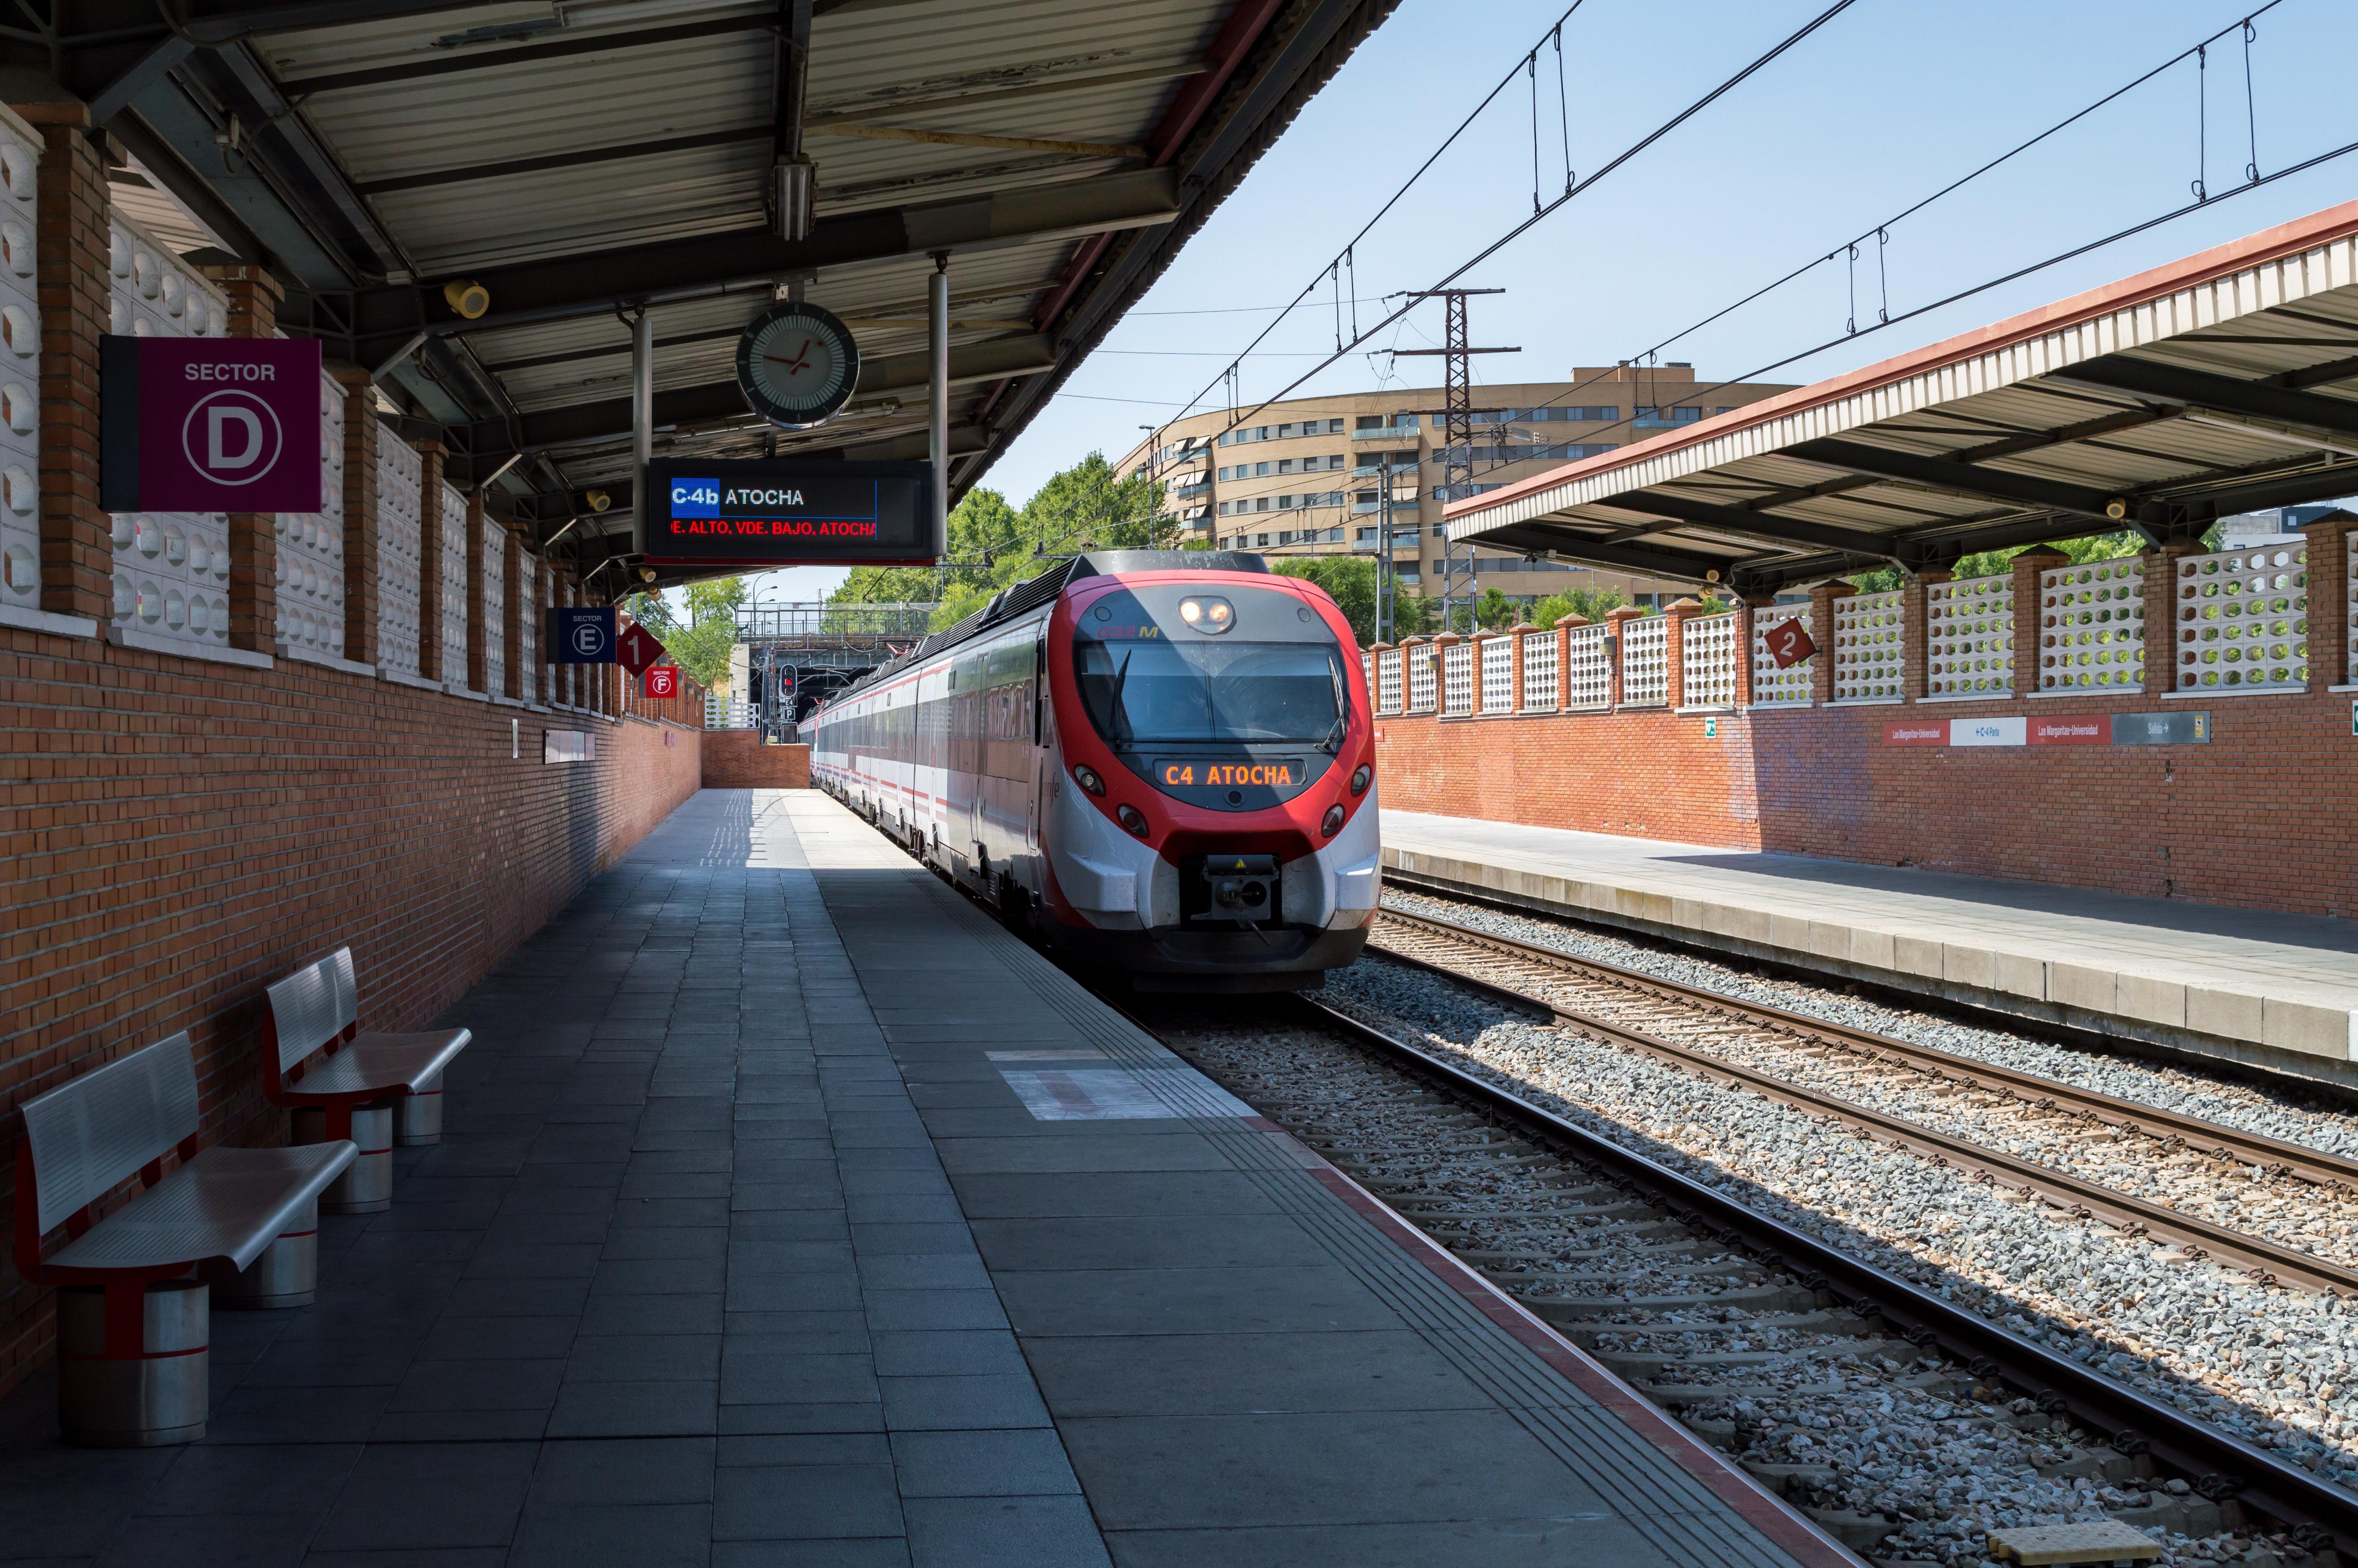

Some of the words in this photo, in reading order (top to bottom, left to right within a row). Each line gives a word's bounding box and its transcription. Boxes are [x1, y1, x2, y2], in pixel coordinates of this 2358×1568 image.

[185, 363, 275, 381] SECTOR
[208, 406, 263, 468] D
[725, 489, 804, 505] ATOCHA
[671, 521, 685, 533] E.
[689, 521, 732, 535] ALTO,
[736, 522, 768, 534] VDE.
[772, 522, 816, 535] BAJO,
[580, 630, 596, 650] E
[1780, 631, 1796, 657] 2
[628, 635, 639, 665] 1
[657, 679, 666, 690] F
[787, 710, 792, 719] P
[1899, 728, 1940, 740] Margaritas-Universidad
[1990, 727, 2000, 736] Parla
[2038, 725, 2046, 736] Las
[2047, 724, 2098, 738] Margaritas-Universidad
[2148, 723, 2163, 734] Salida
[1166, 766, 1193, 785] C4
[1207, 766, 1291, 785] ATOCHA
[1042, 772, 1059, 808] renfe
